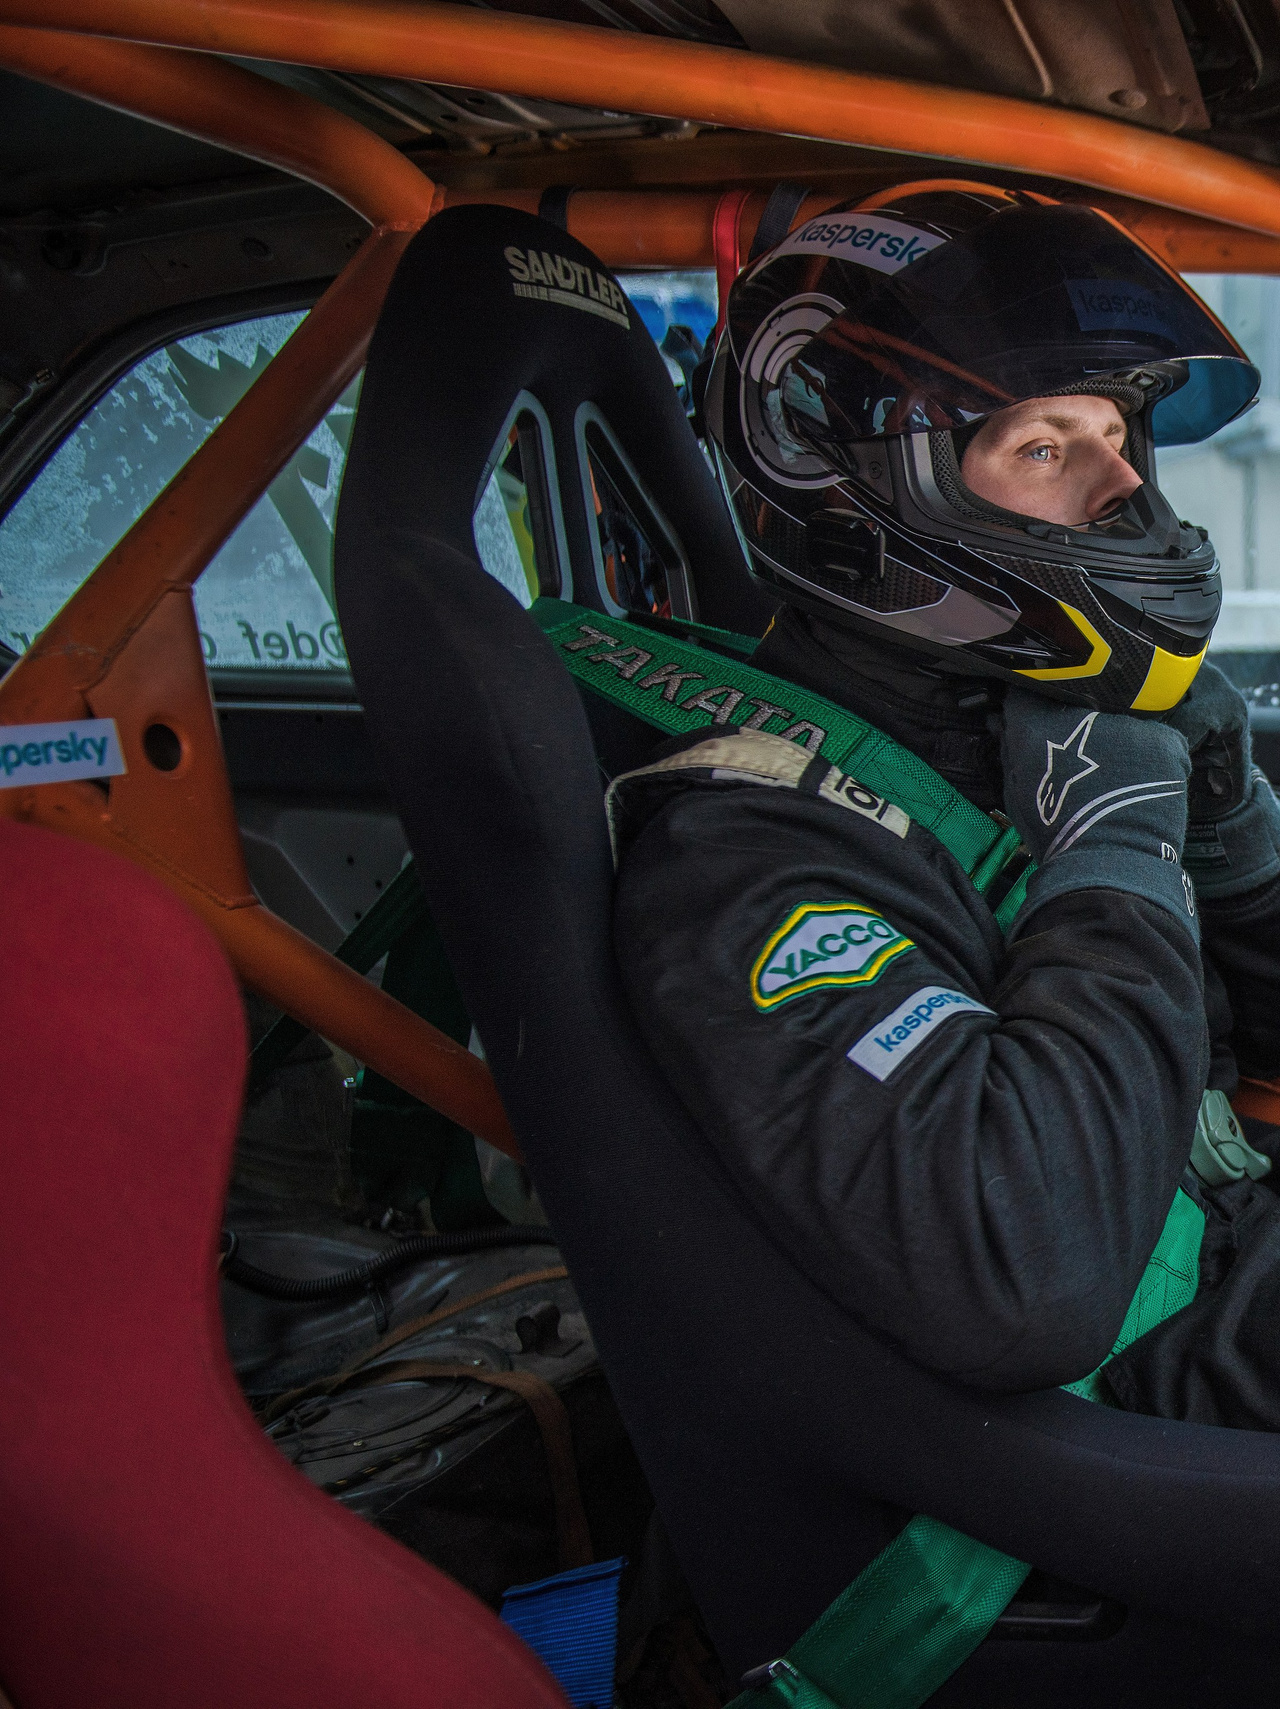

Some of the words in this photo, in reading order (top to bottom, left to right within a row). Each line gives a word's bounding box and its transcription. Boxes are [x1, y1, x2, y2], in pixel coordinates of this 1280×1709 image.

[795, 222, 931, 264] kaspersk
[504, 246, 628, 315] SANDTLER
[561, 624, 827, 753] TAKATA
[0, 731, 108, 776] persky
[767, 919, 896, 980] YACCO
